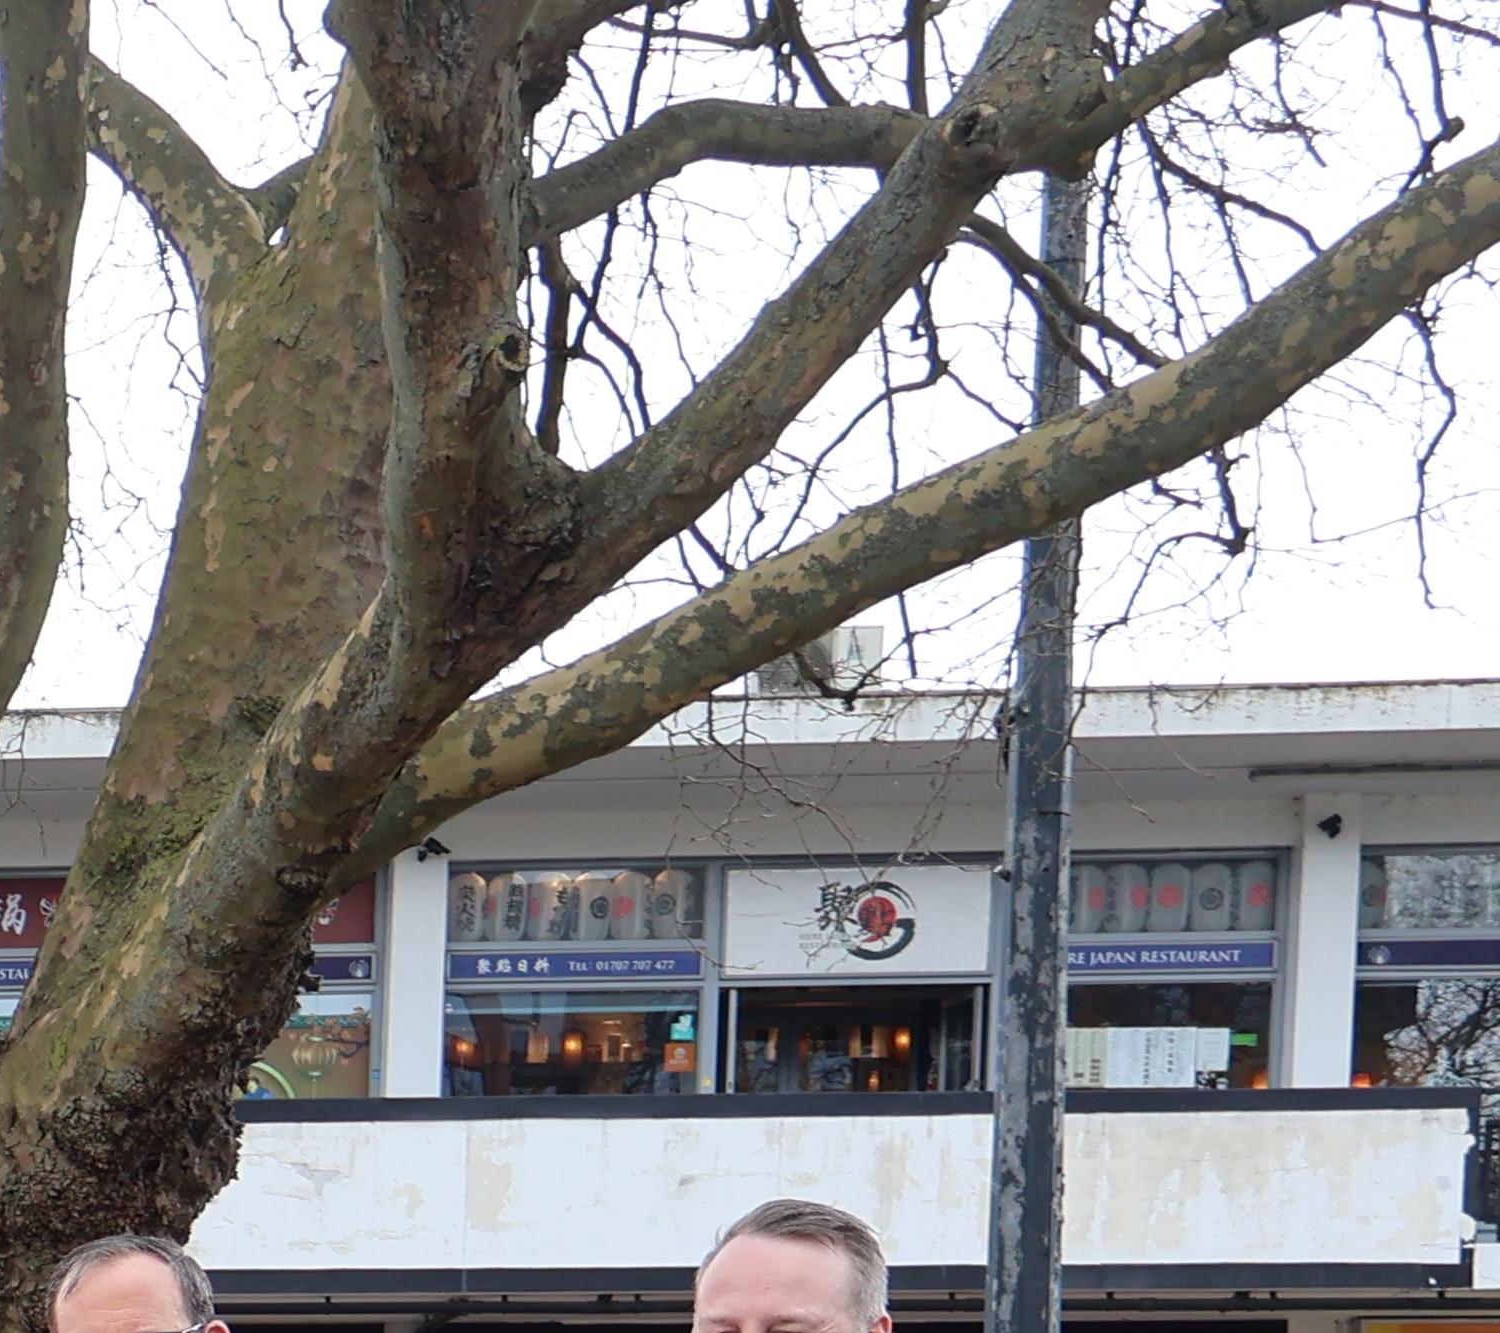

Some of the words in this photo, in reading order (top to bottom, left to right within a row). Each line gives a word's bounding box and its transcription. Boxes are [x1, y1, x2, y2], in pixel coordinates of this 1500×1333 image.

[1067, 952, 1086, 965] RE
[1089, 951, 1136, 966] JAPAN
[1140, 949, 1242, 964] RESTAURANT
